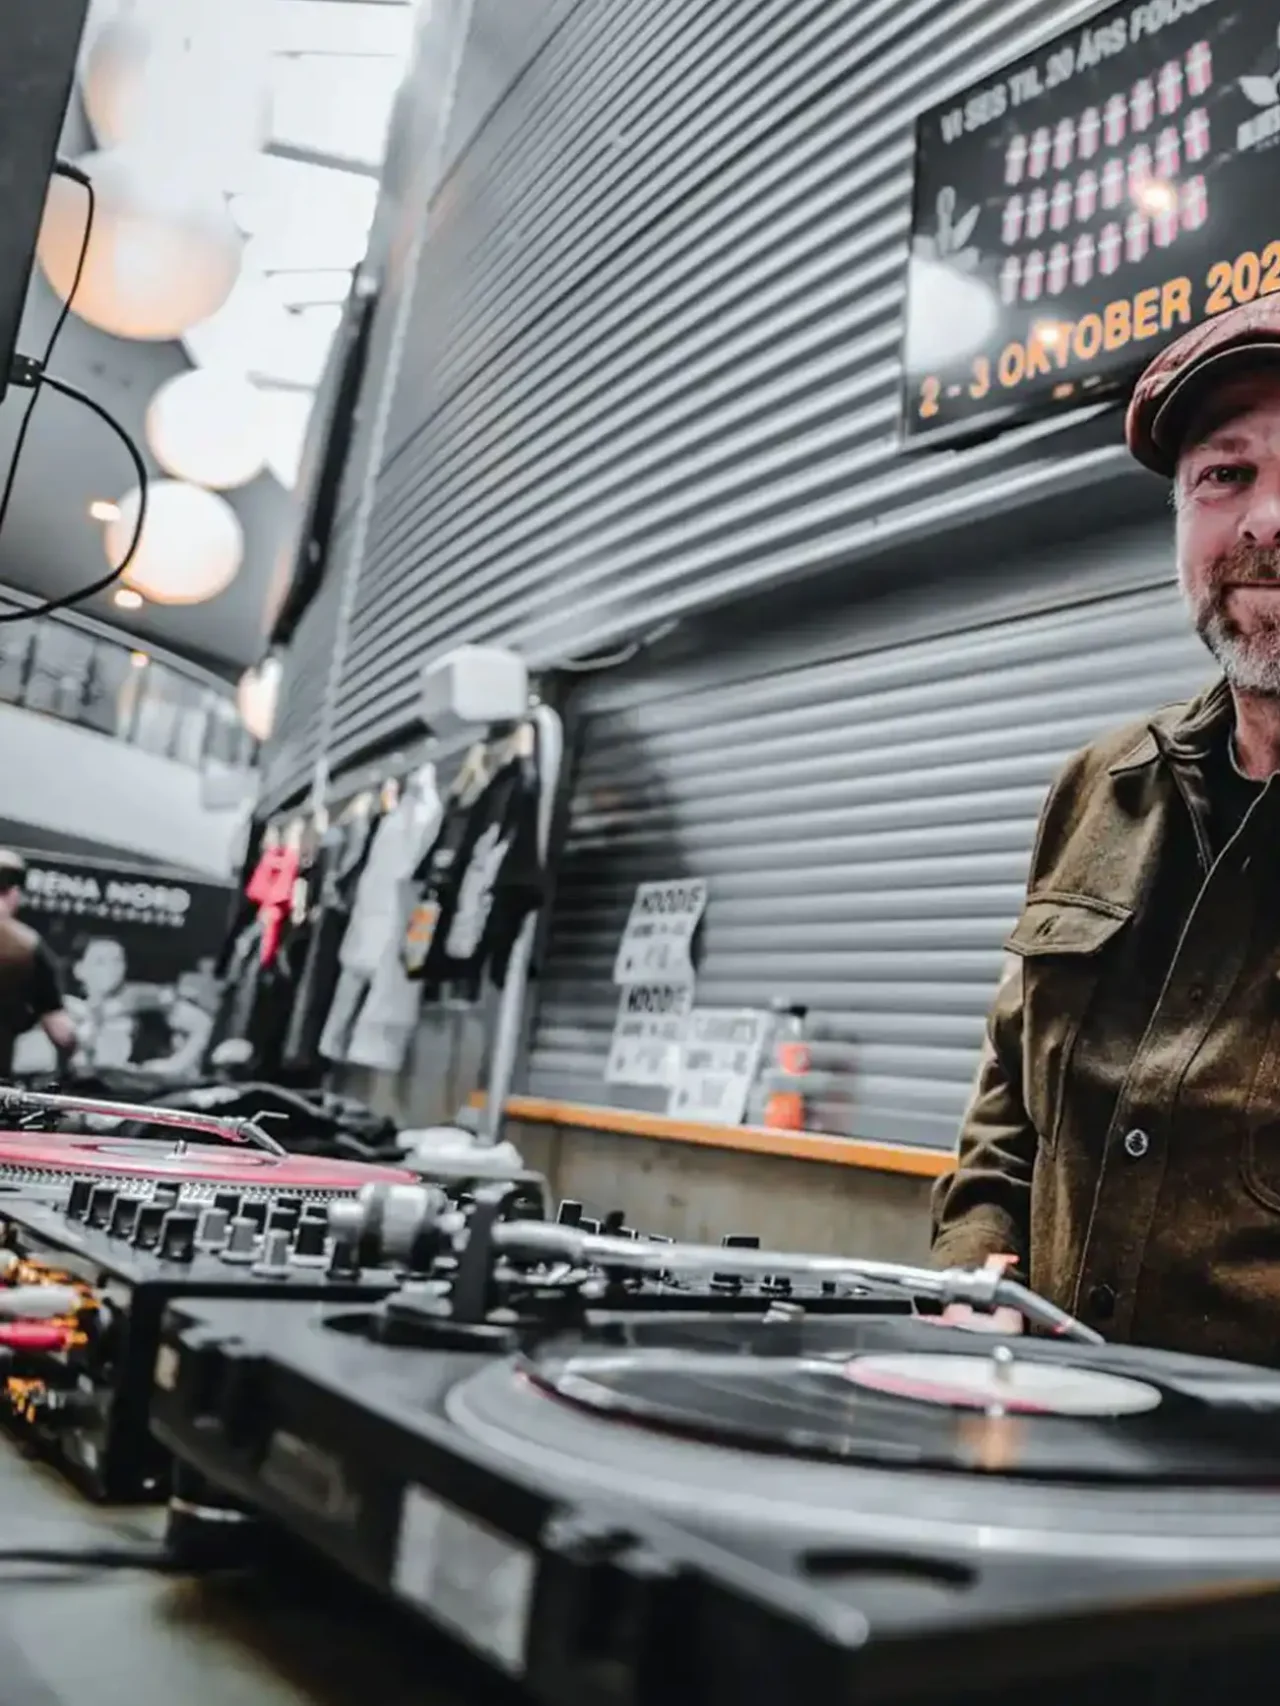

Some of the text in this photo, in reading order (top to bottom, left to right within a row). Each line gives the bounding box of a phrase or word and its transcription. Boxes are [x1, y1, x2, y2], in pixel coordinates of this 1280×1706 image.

[919, 376, 941, 418] 2
[967, 356, 991, 399] 3
[998, 276, 1193, 388] OKTOBER
